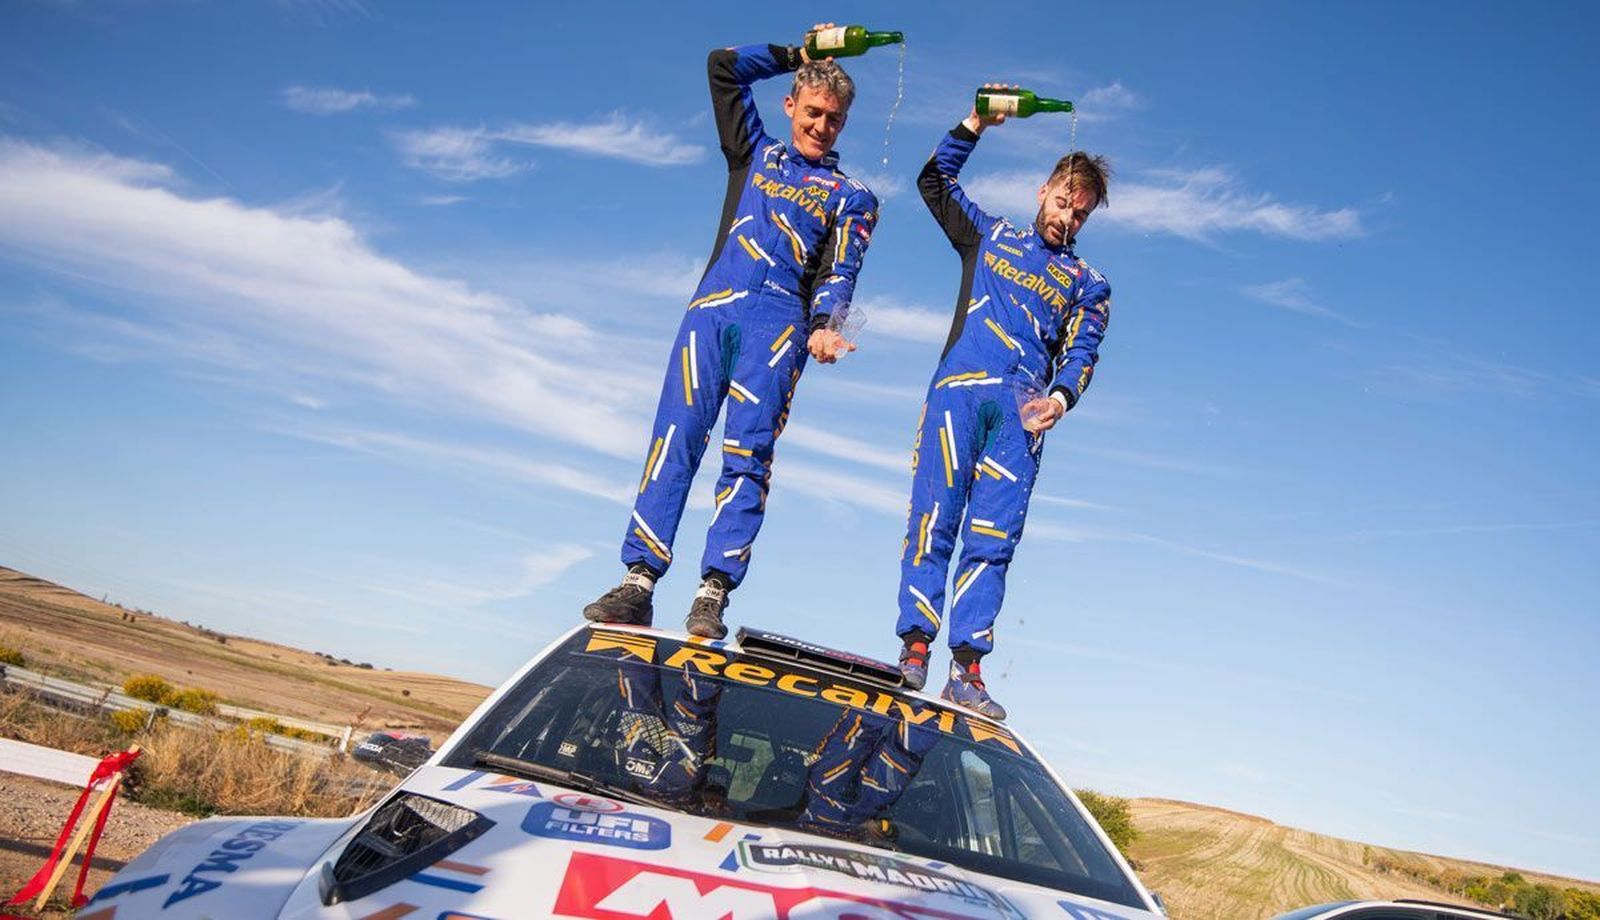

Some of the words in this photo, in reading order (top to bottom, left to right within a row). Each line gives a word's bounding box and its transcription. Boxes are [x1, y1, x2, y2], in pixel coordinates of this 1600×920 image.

[992, 257, 1057, 301] Recalvi
[665, 646, 956, 734] Recalvi
[545, 821, 649, 842] FILTERS
[551, 807, 650, 833] UFI
[762, 847, 851, 869] RALLYE
[850, 860, 990, 901] MADRID
